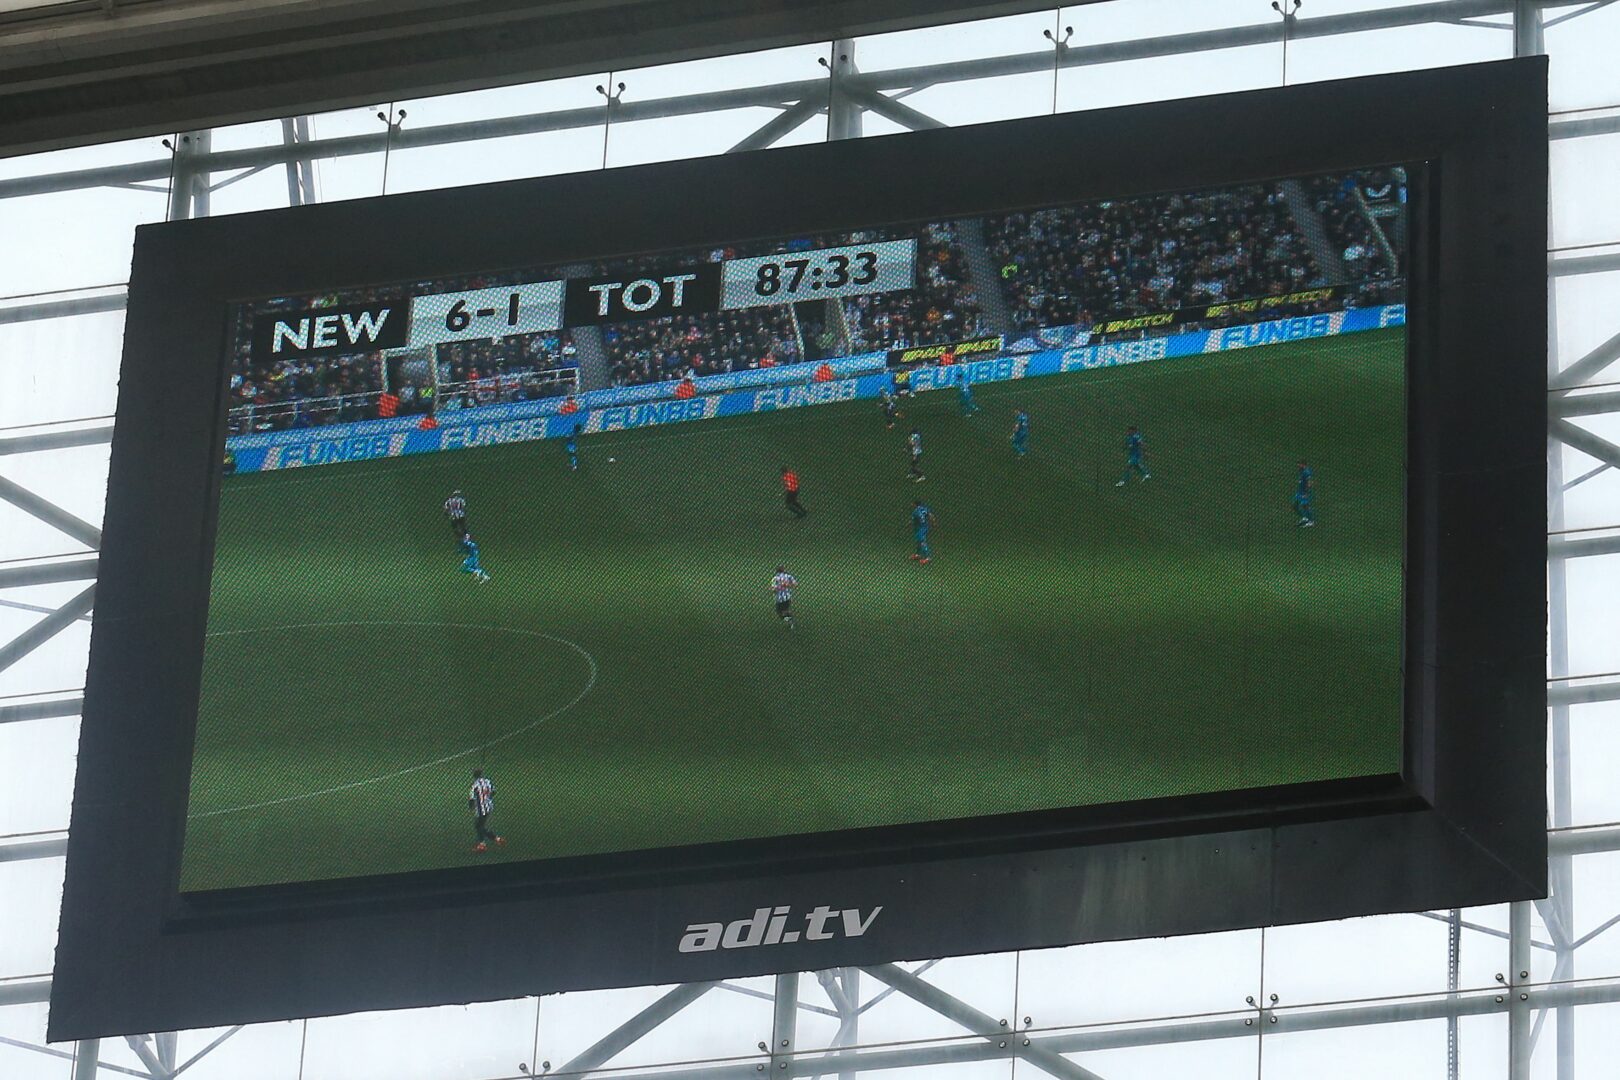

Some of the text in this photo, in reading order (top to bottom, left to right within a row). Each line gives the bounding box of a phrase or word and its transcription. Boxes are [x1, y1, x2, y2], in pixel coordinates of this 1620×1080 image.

[272, 309, 391, 353] NEW
[588, 273, 696, 316] TOT
[754, 252, 878, 296] 87:33
[678, 905, 884, 952] adi.tv
